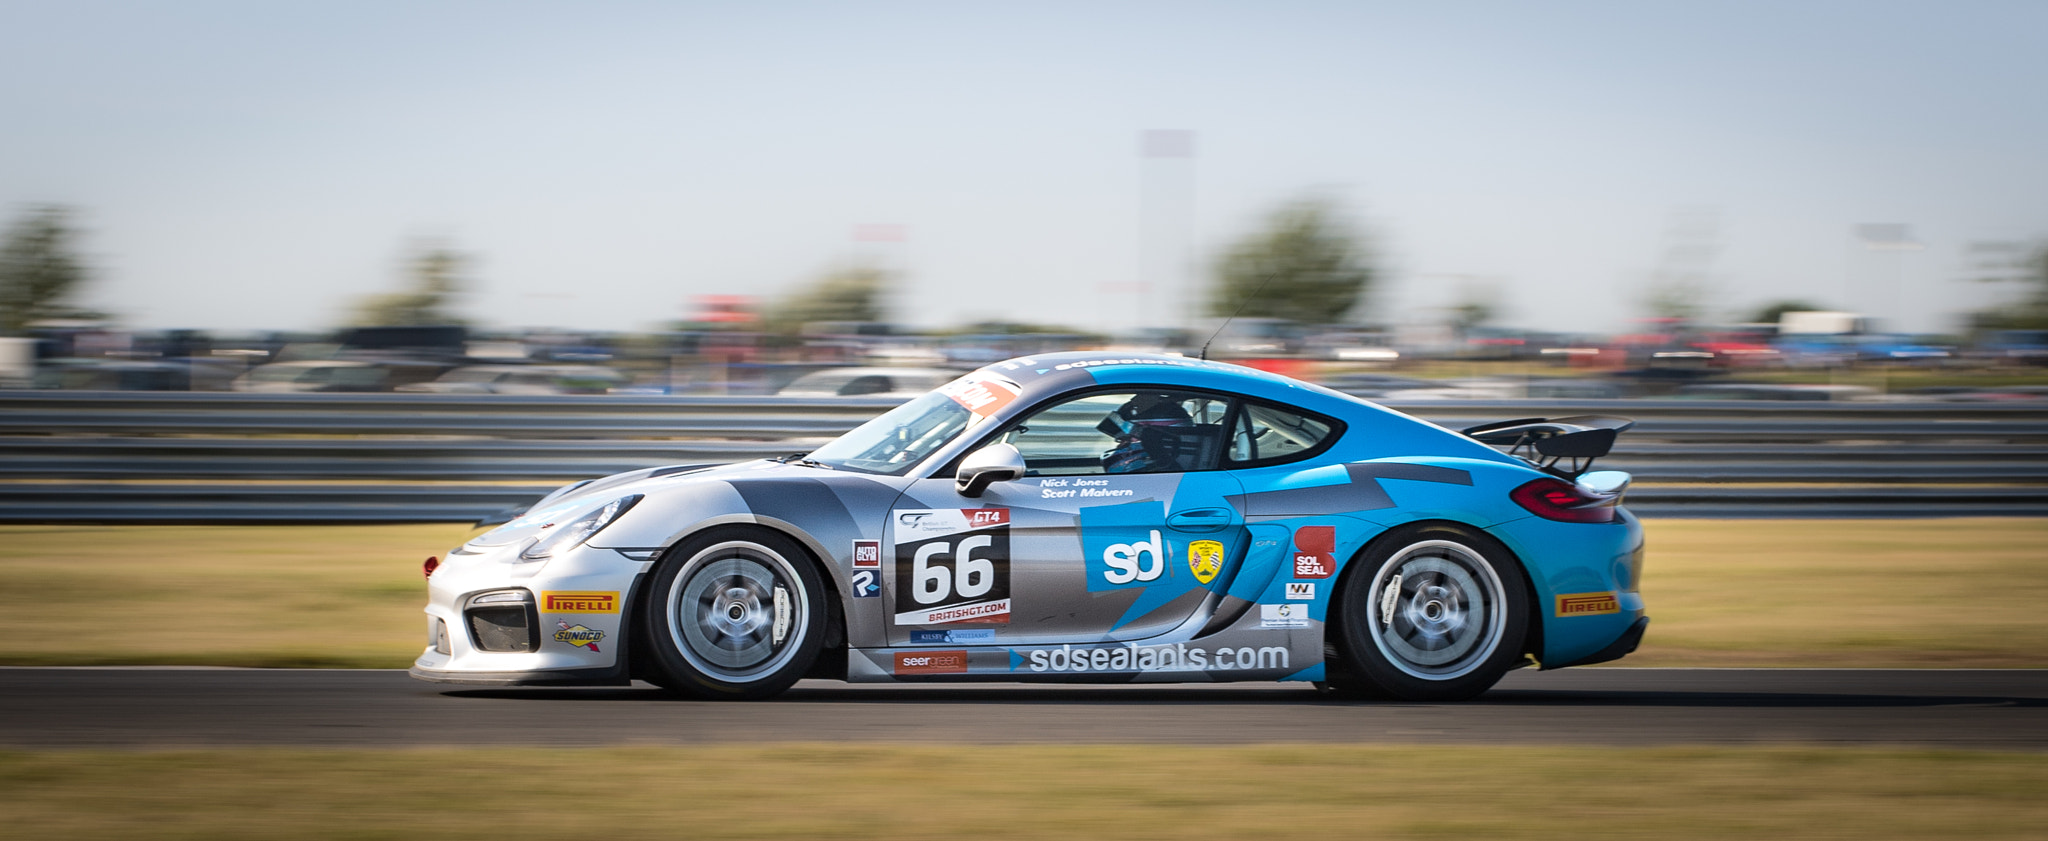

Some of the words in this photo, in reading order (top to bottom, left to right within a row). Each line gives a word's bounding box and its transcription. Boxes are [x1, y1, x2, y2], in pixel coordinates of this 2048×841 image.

[1040, 479, 1069, 488] Nick
[1072, 479, 1109, 487] Jones
[1041, 488, 1077, 498] Scott
[1079, 487, 1133, 498] Malvern
[974, 511, 1001, 523] GT4
[857, 546, 877, 554] AUTO
[1103, 529, 1165, 585] sd
[1296, 556, 1320, 566] SOL
[912, 534, 995, 605] 66
[1296, 566, 1328, 575] SEAL
[547, 595, 613, 610] PIRELLI
[1561, 595, 1617, 613] PIRELLI
[929, 602, 1006, 622] BRITISHGT.COM
[557, 631, 602, 640] SUNOCO
[1030, 643, 1289, 672] sdsealants.com
